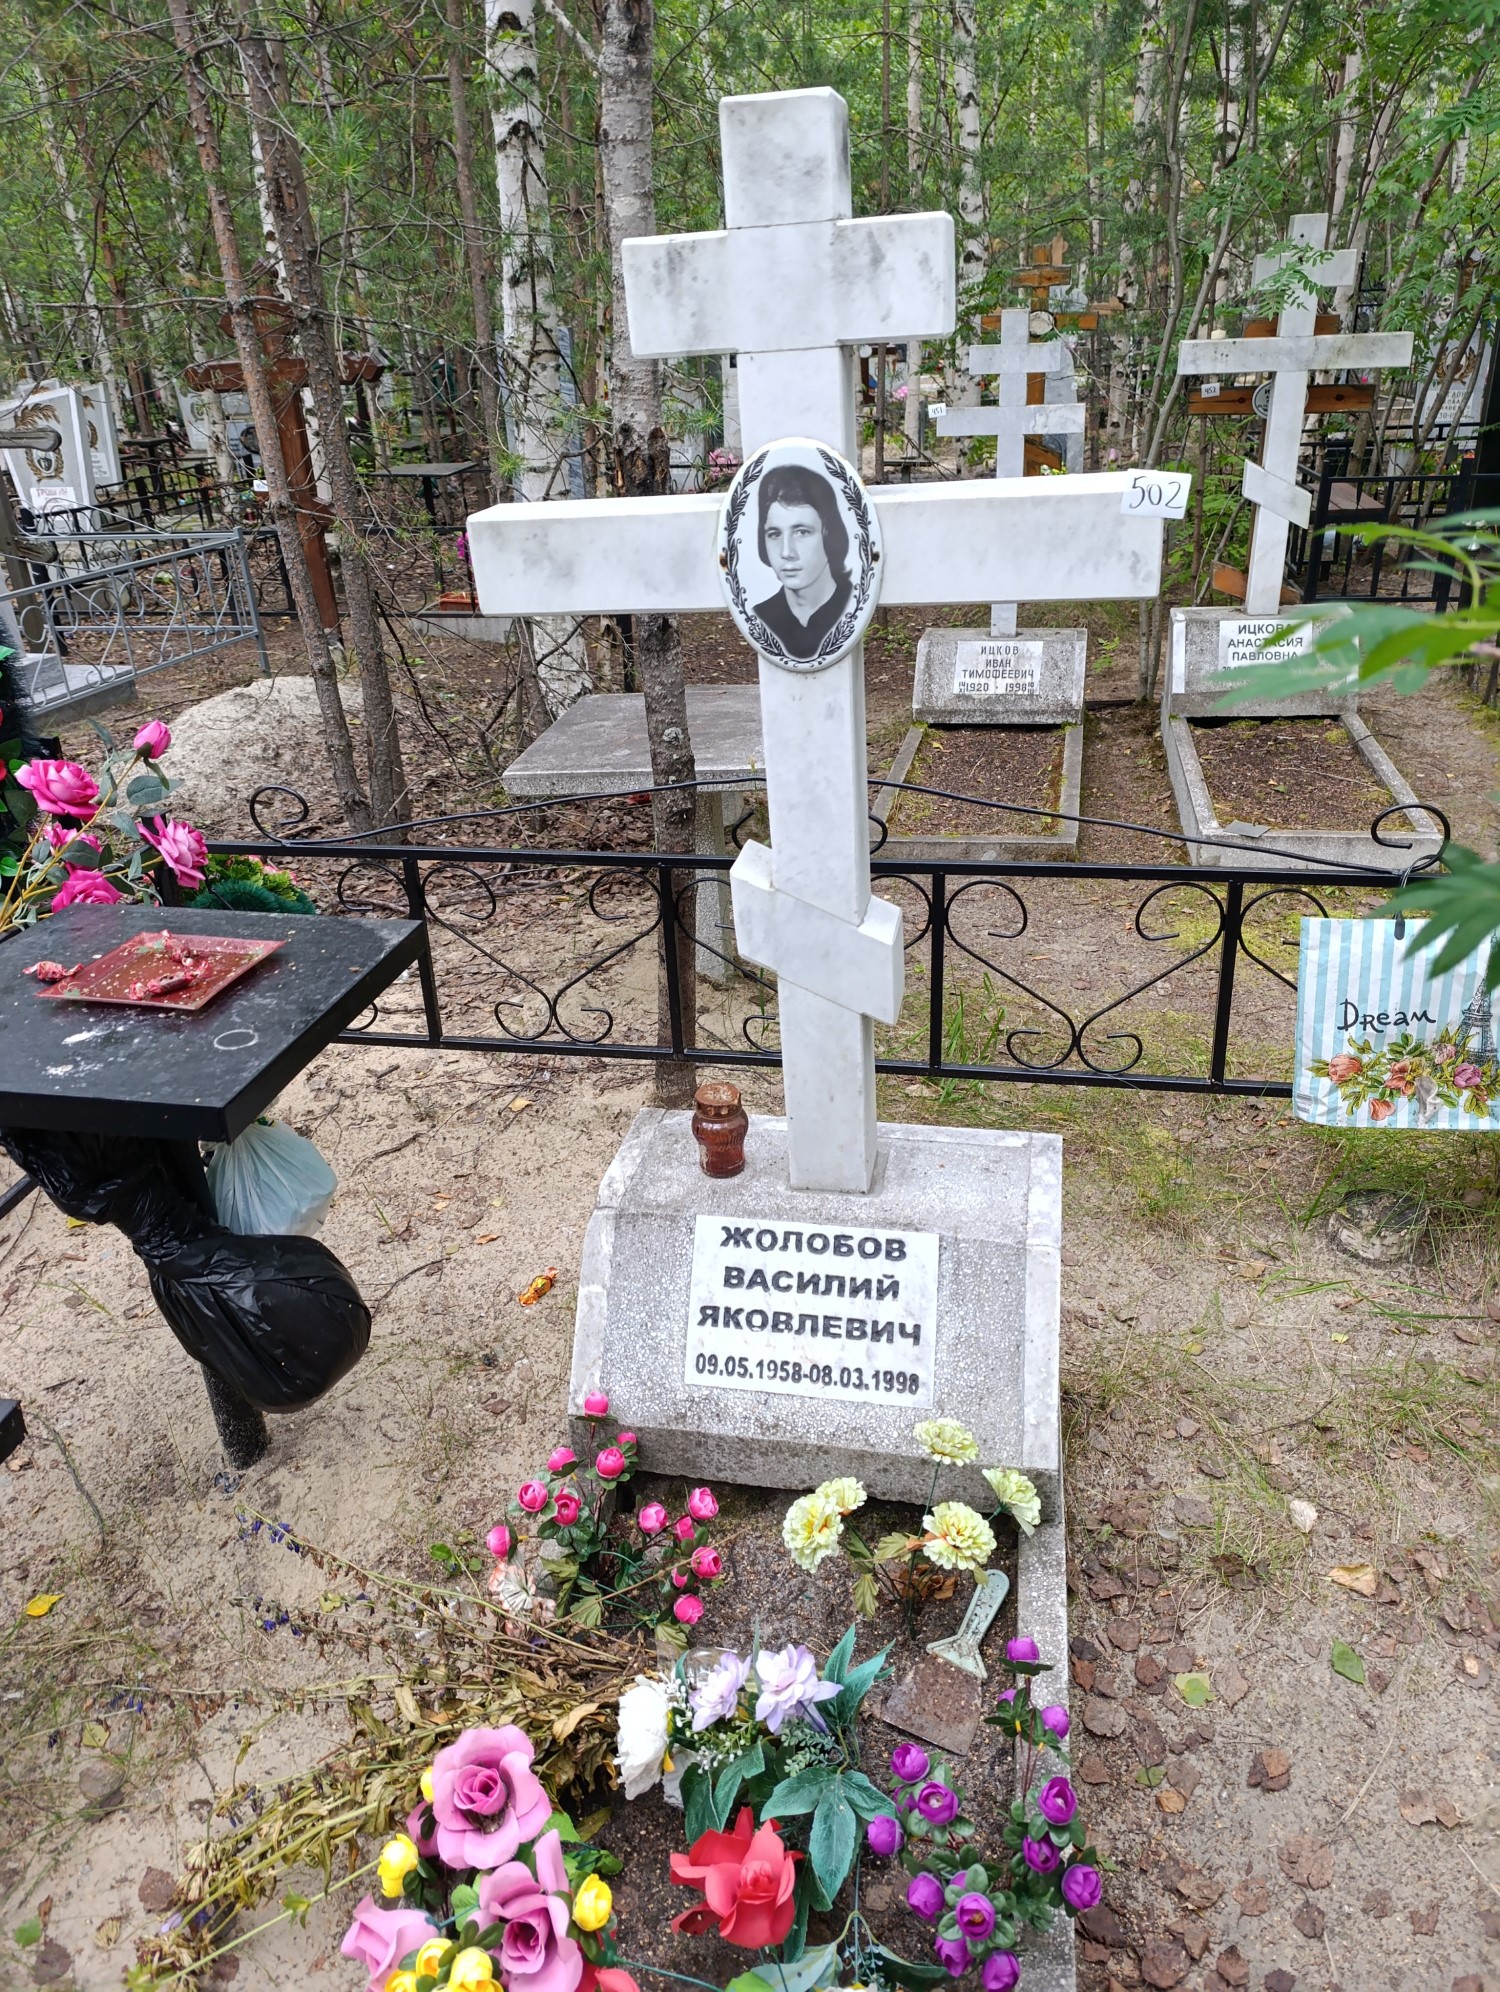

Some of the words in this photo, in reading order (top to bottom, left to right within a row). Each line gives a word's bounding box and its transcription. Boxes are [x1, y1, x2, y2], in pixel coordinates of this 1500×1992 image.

[1129, 475, 1184, 509] 502
[980, 645, 1019, 655] ИЦКОВ
[985, 659, 1011, 668] ИВАН
[1232, 651, 1299, 661] ПАВЛОВНА
[962, 669, 1034, 679] ТИМОФЕЕВИЧ
[966, 682, 989, 692] 1920
[1005, 682, 1027, 692] 1998
[1336, 998, 1436, 1033] Dream
[719, 1225, 907, 1262] ЖОЛОБОВ
[723, 1265, 900, 1302] ВАСИЛИЙ
[697, 1305, 922, 1347] ЯКОВЛЕВИЧ
[695, 1352, 920, 1396] 09.05.1958-08.03.1998
